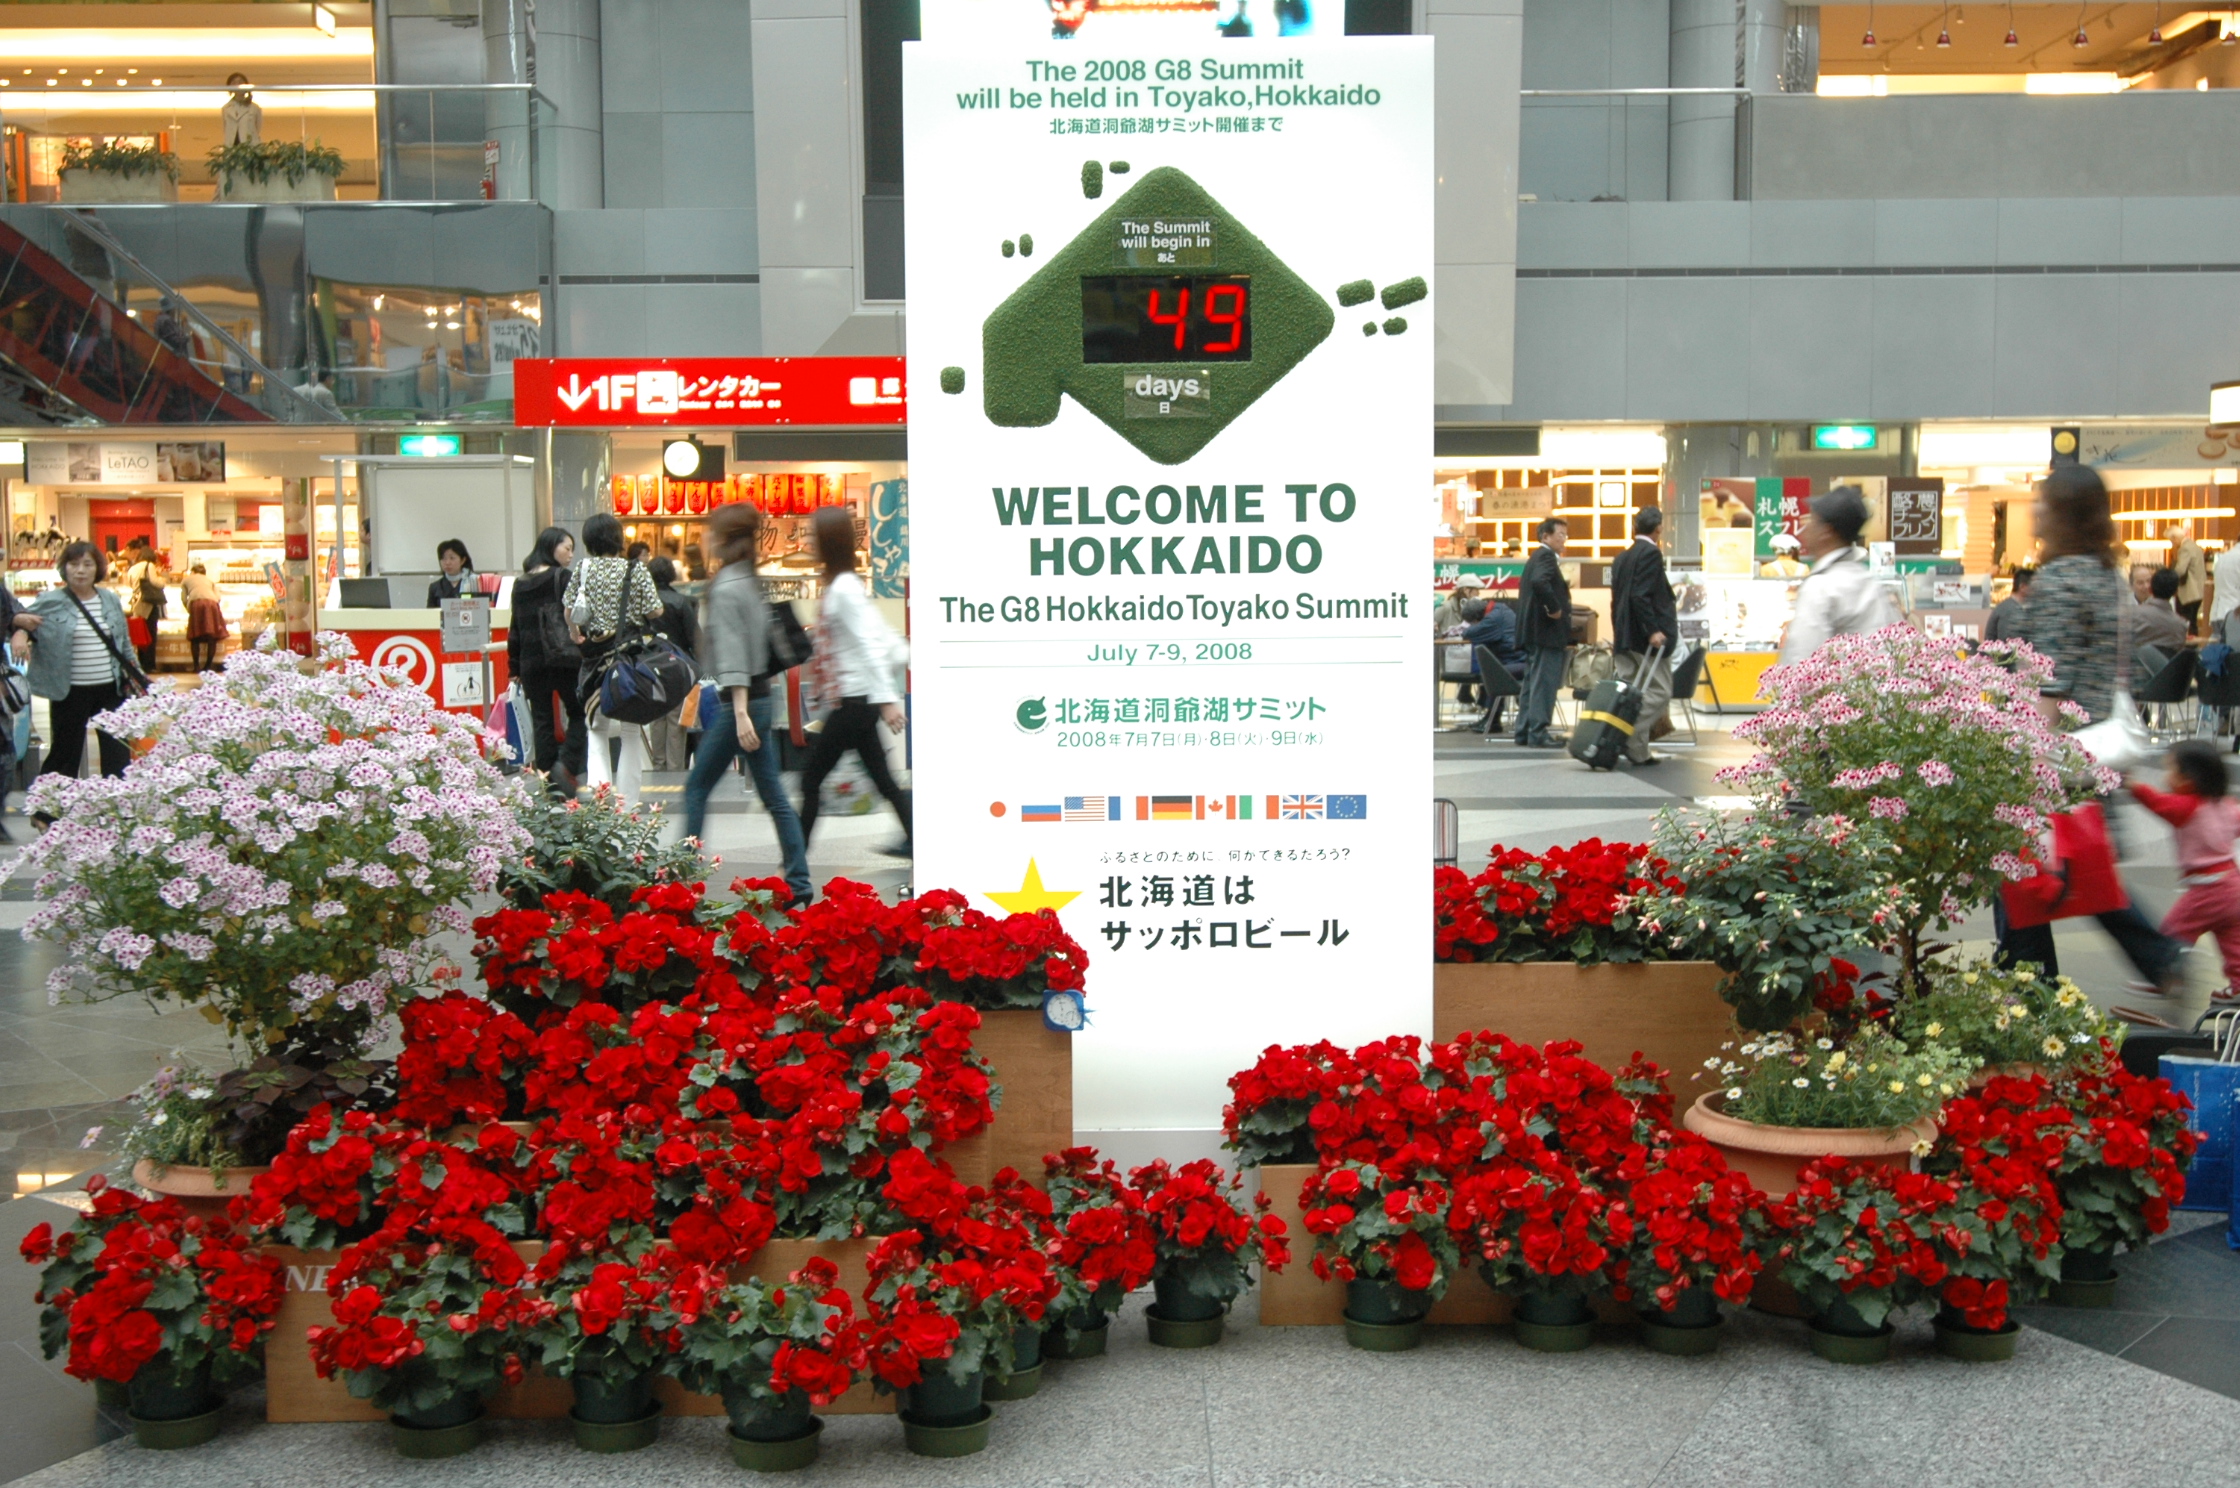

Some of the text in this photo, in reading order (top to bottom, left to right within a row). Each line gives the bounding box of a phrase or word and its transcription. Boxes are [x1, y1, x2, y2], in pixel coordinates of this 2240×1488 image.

[1026, 57, 1304, 82] The 2008 G8 Summit
[956, 88, 1000, 110] will
[1009, 87, 1042, 109] be
[1051, 86, 1106, 109] held
[1115, 85, 1139, 108] in
[1050, 116, 1284, 135] 北海道洞爺湖サミット開催まで
[1121, 220, 1211, 235] The Summit
[1121, 235, 1211, 251] will begin in
[1157, 253, 1176, 264] あと
[1146, 283, 1247, 353] 49
[592, 374, 636, 411] 1F
[679, 375, 782, 399] レンタカー
[1134, 373, 1200, 401] days
[1158, 401, 1171, 414] 日
[108, 456, 150, 469] LeTAO
[992, 483, 1357, 526] WELCOME TO
[1757, 496, 1800, 517] 札幌
[1030, 534, 1323, 577] HOKKAIDO
[940, 592, 1409, 628] The G8 Hokkaido Toyako Summit
[1087, 642, 1253, 666] July 7-9, 2008
[1054, 696, 1327, 725] 北海道洞爺湖サミット
[1099, 873, 1256, 908] 北海道は
[1100, 917, 1350, 953] サッポロビール
